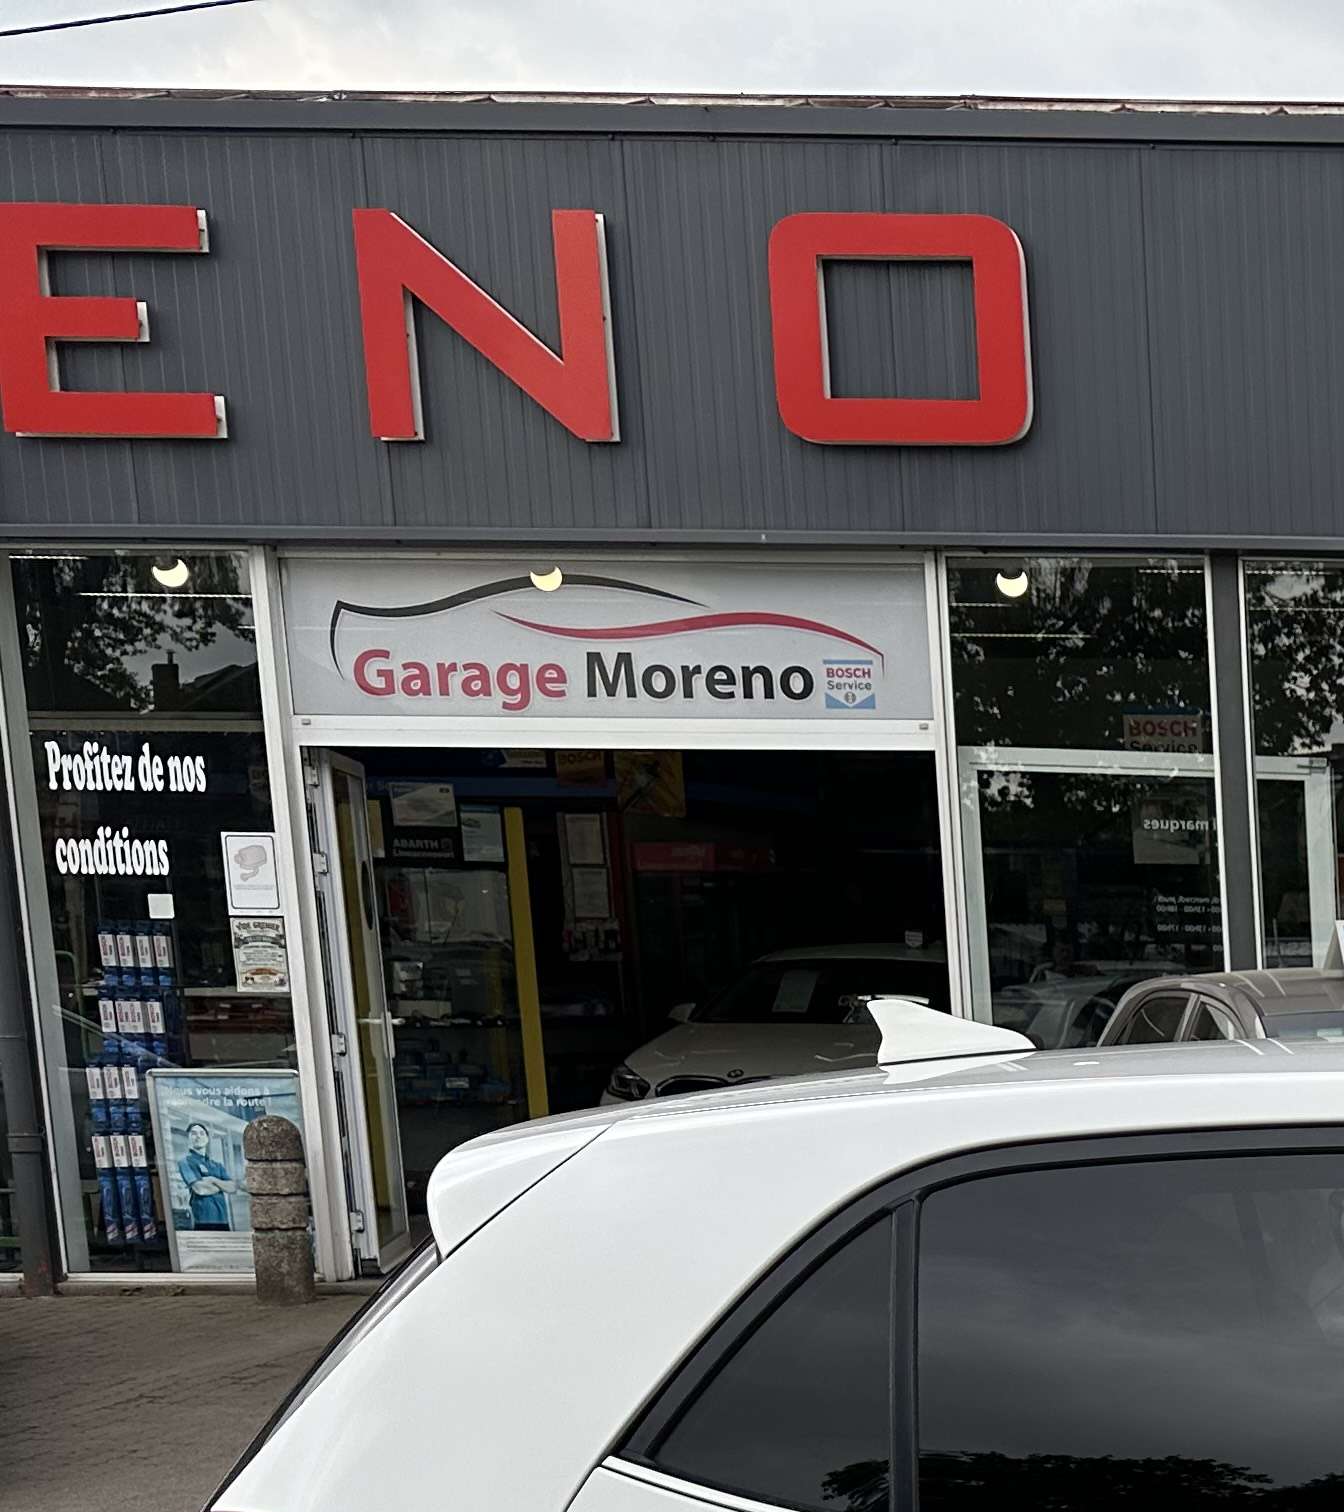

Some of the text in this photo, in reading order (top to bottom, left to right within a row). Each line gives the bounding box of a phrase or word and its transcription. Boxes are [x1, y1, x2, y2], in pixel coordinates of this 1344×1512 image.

[353, 649, 815, 712] Garage Moreno
[826, 667, 872, 679] BOSCH
[826, 679, 873, 690] Service
[1129, 719, 1197, 737] BOSCH
[44, 740, 207, 793] Profitez de nos
[55, 826, 170, 876] conditions
[195, 1087, 221, 1096] vous
